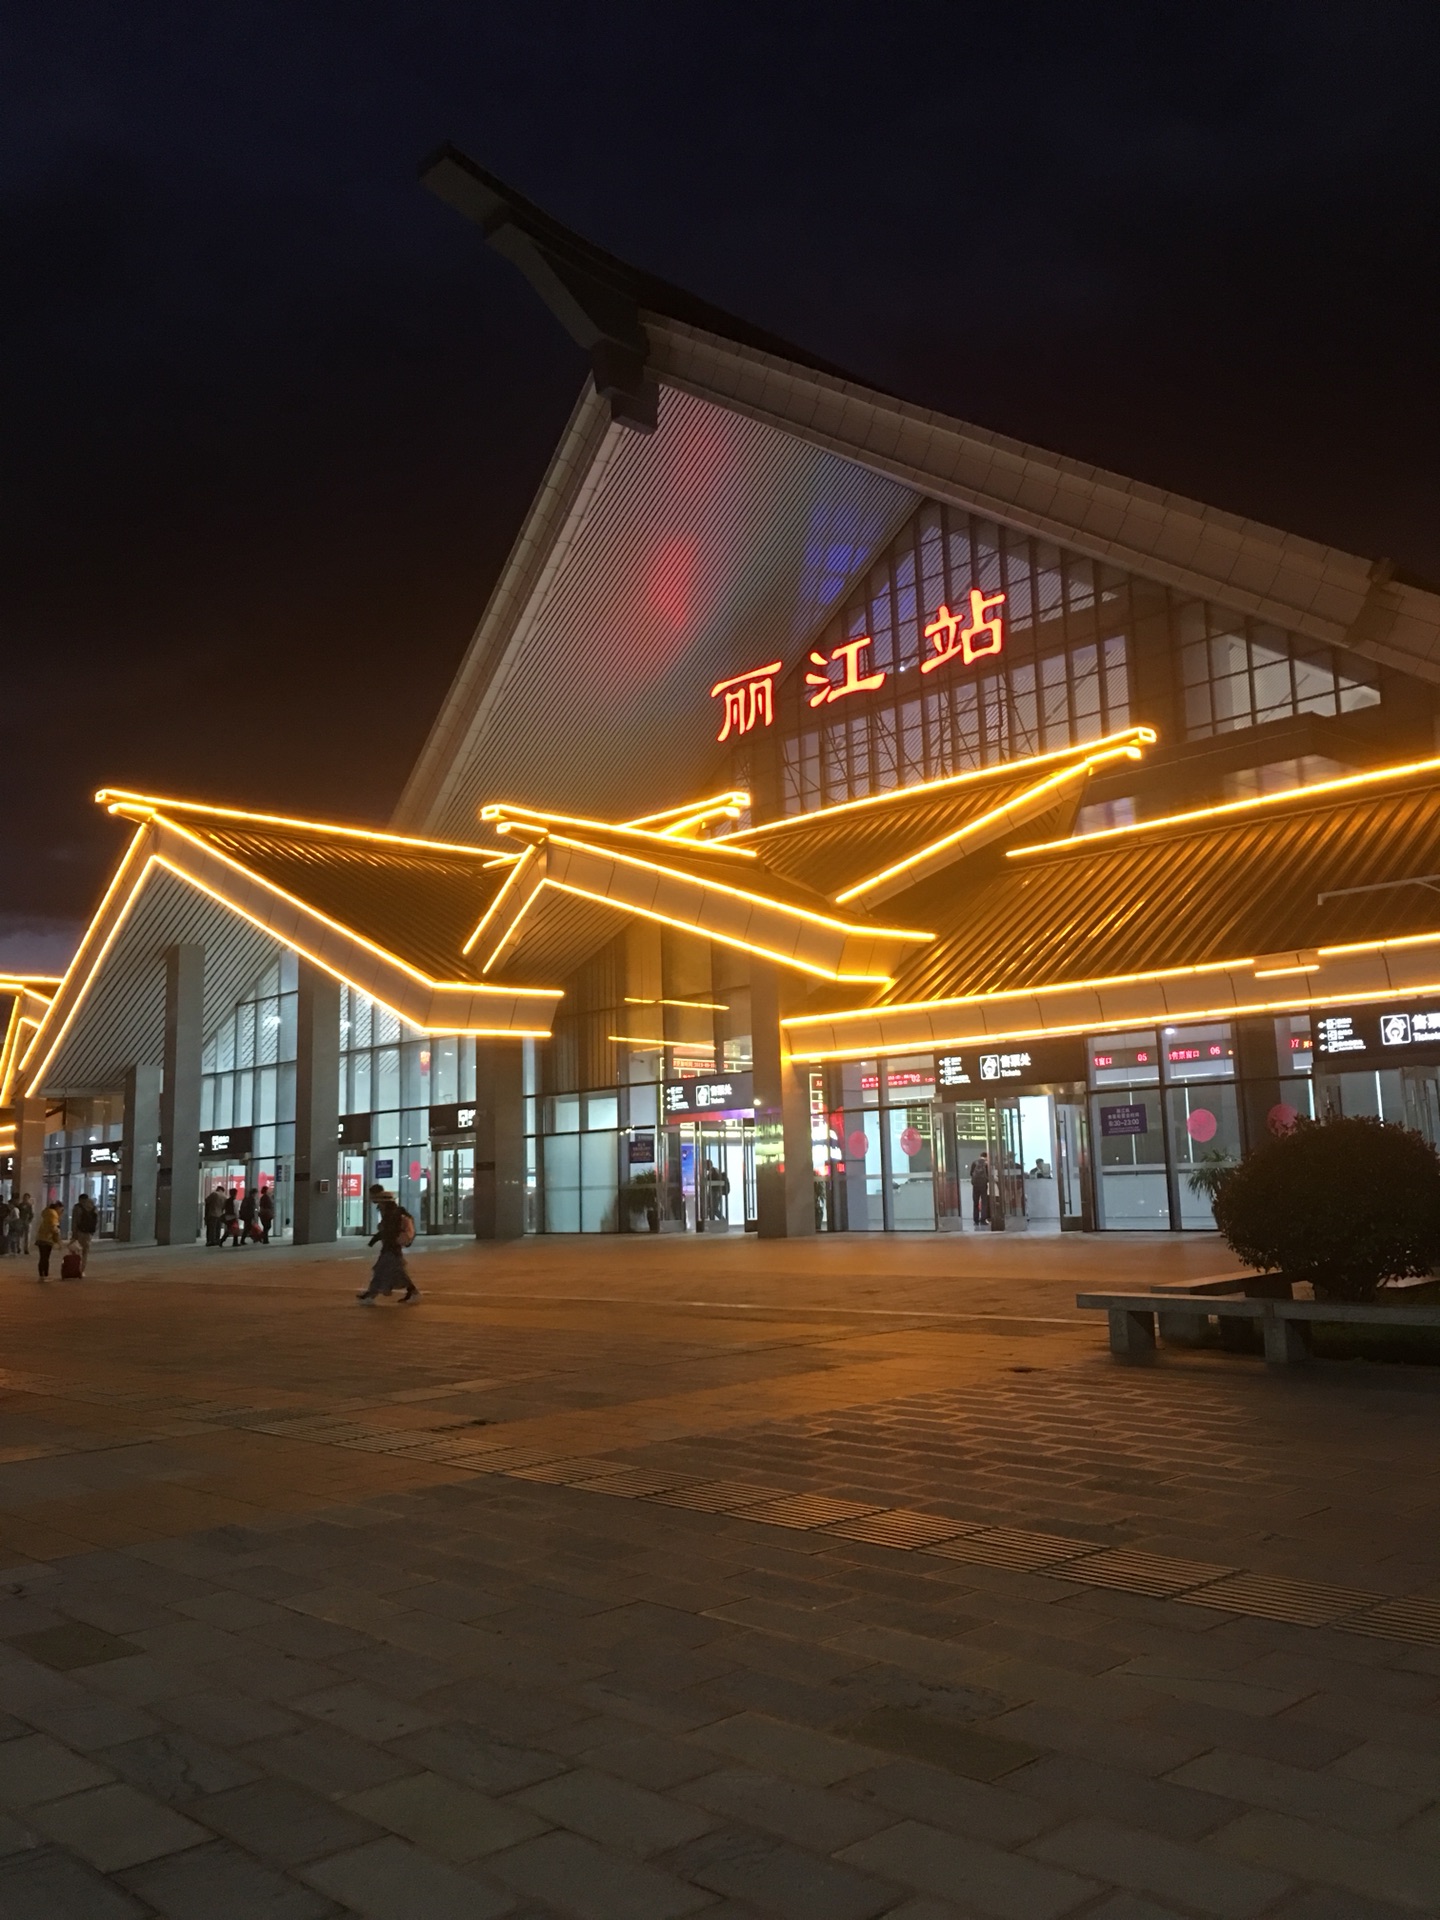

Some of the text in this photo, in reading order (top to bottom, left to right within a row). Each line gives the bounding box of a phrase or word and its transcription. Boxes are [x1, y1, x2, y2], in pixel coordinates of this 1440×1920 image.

[711, 589, 1006, 742] 丽江站
[1412, 1031, 1440, 1042] Ticket
[1210, 1046, 1220, 1055] 06
[1000, 1053, 1031, 1068] 售票处
[1137, 1053, 1148, 1062] 05
